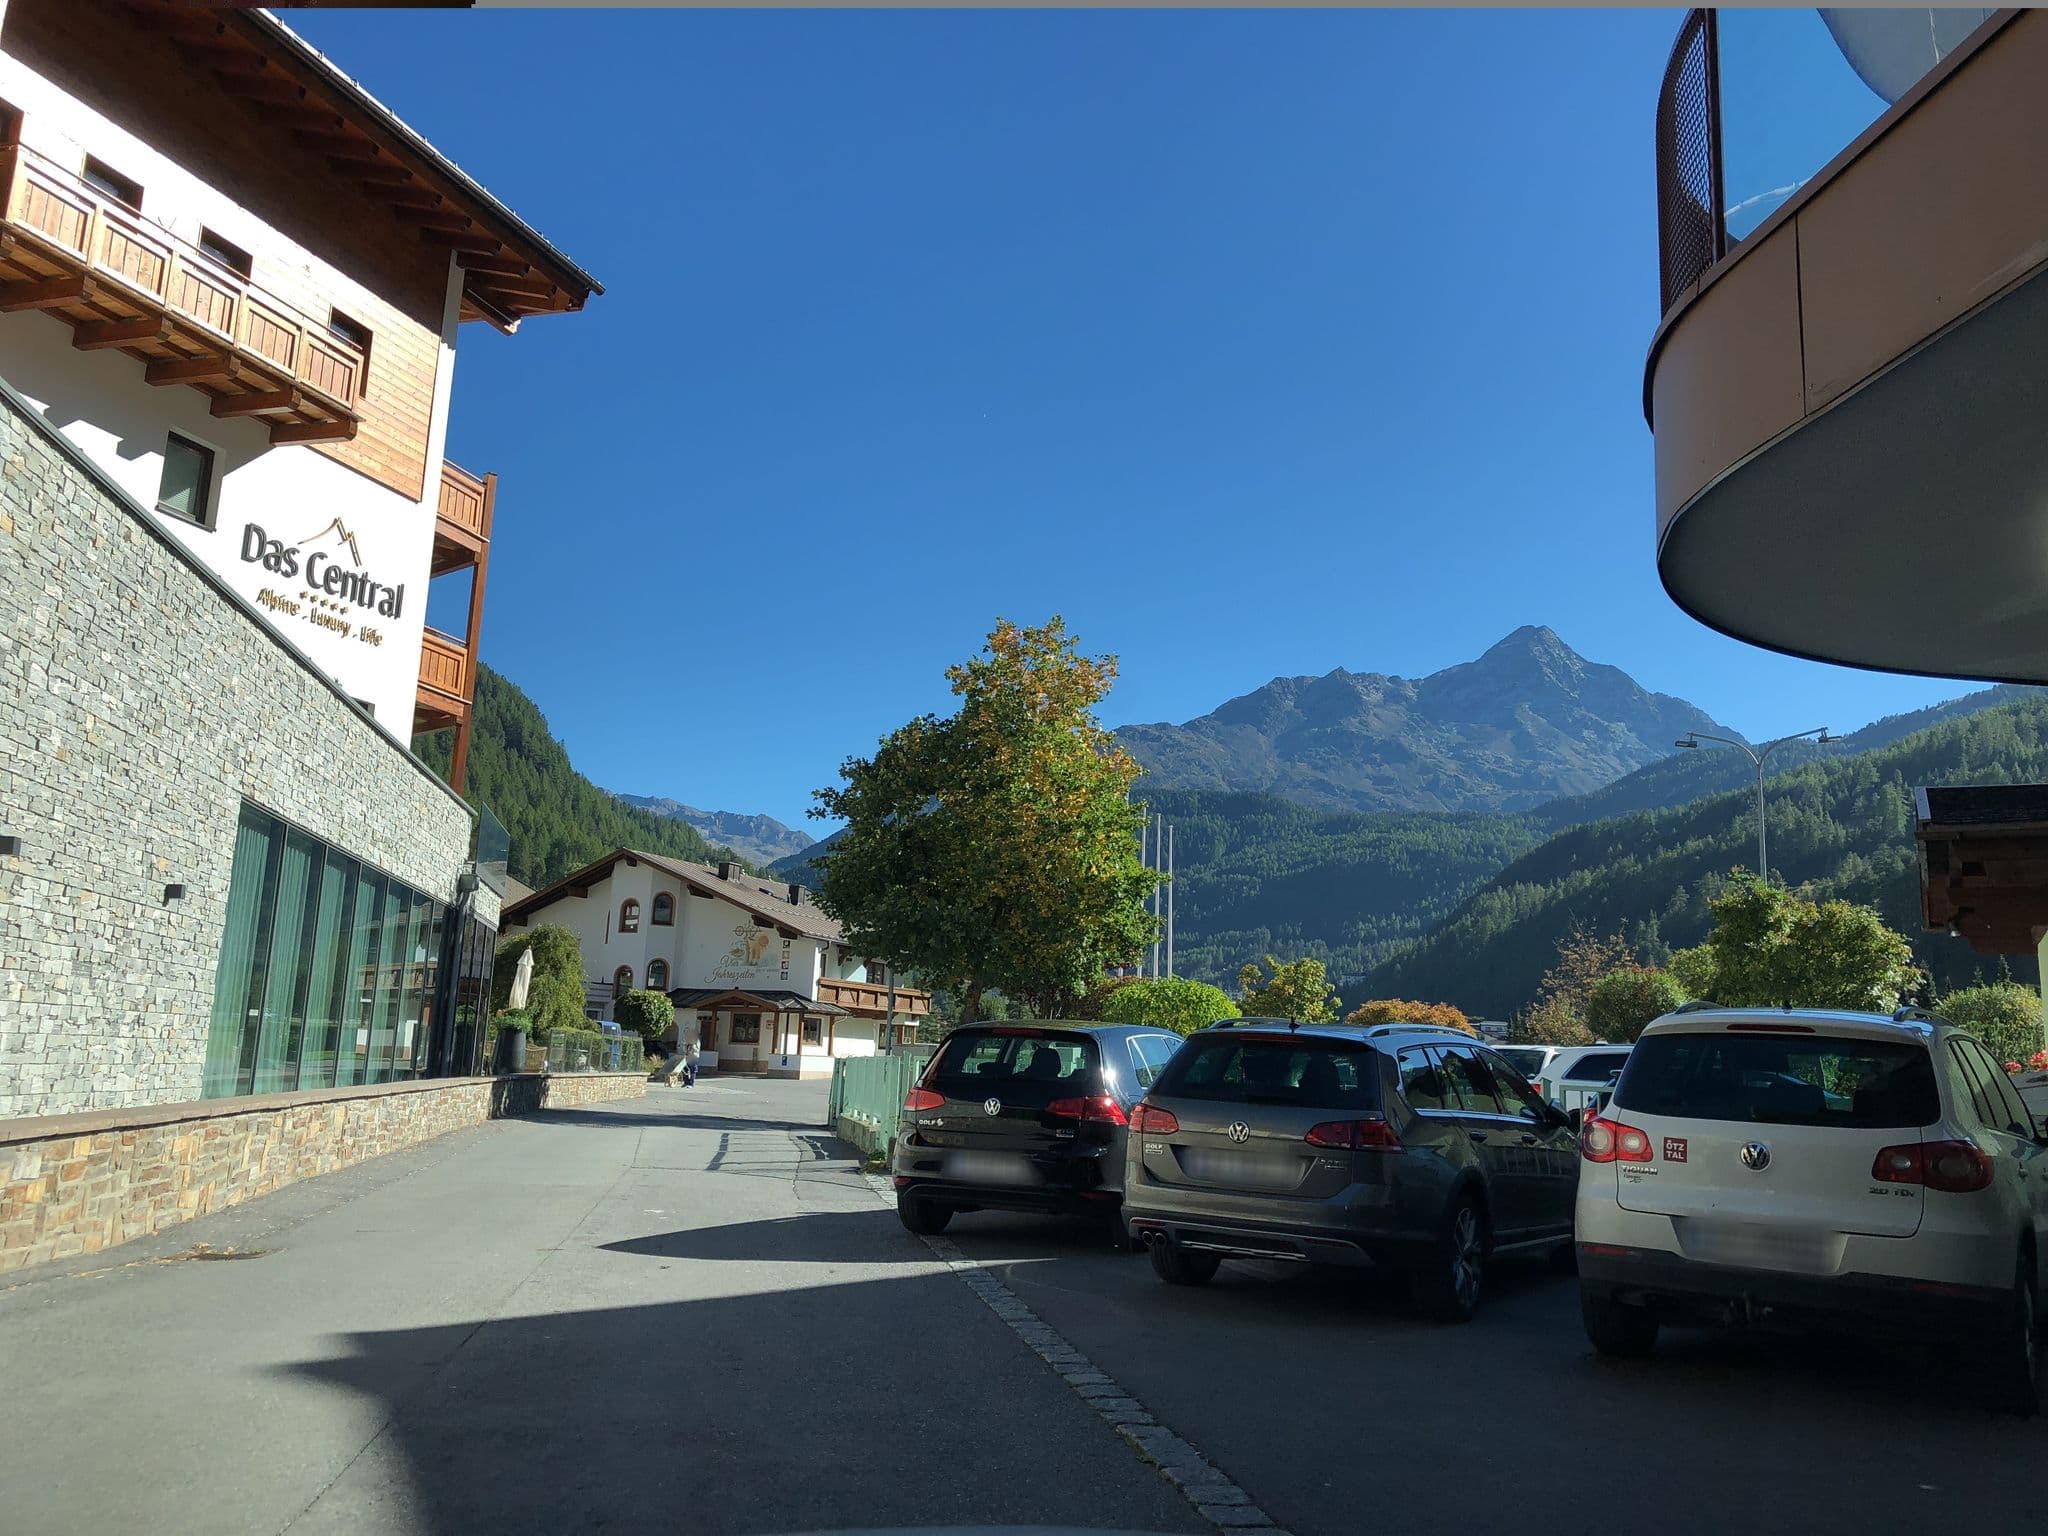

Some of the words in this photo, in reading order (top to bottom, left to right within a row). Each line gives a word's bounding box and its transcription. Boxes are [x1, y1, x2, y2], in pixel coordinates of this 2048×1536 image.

[240, 522, 300, 578] Das
[306, 552, 405, 619] Central
[255, 587, 301, 616] Alpine
[1666, 1151, 1684, 1160] TAL
[1621, 1165, 1658, 1175] TIGUAN
